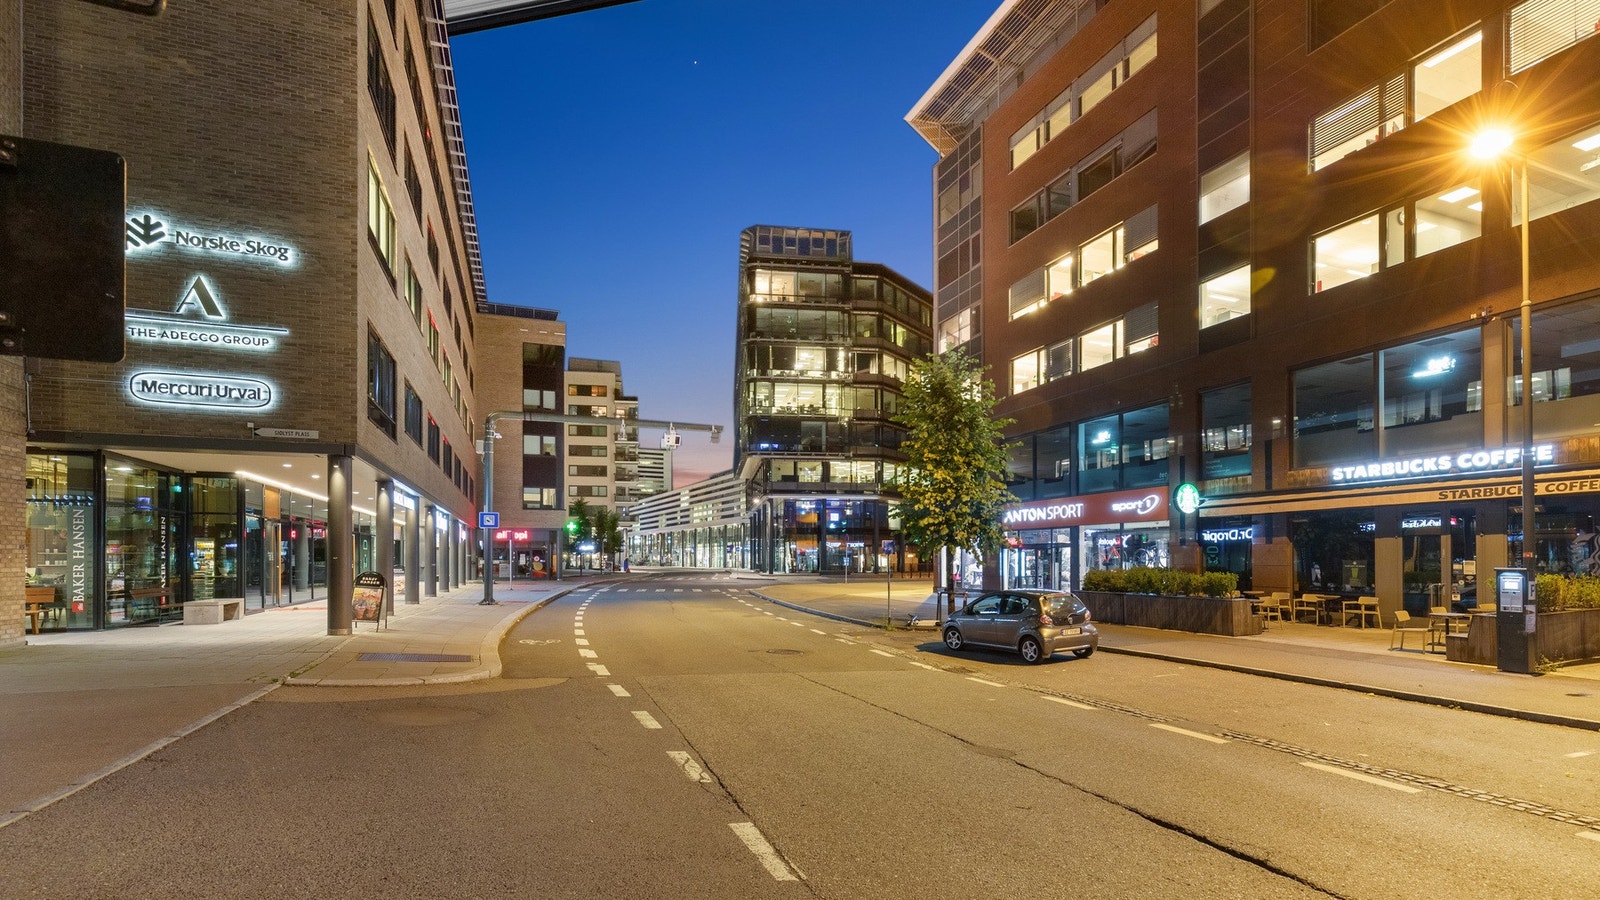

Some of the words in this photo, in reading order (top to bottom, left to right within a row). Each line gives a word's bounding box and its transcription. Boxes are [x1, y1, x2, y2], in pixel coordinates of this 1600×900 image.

[175, 231, 241, 251] Norske
[245, 240, 289, 261] Skog
[128, 327, 156, 338] THE
[161, 330, 219, 343] ADECCO
[223, 335, 269, 347] GROUP
[141, 379, 212, 397] Mercuri
[216, 385, 261, 400] Urval
[1332, 455, 1451, 481] STARBUCKS
[1545, 480, 1600, 493] COFFE
[73, 509, 85, 559] HANSEN
[73, 563, 85, 602] BAKER
